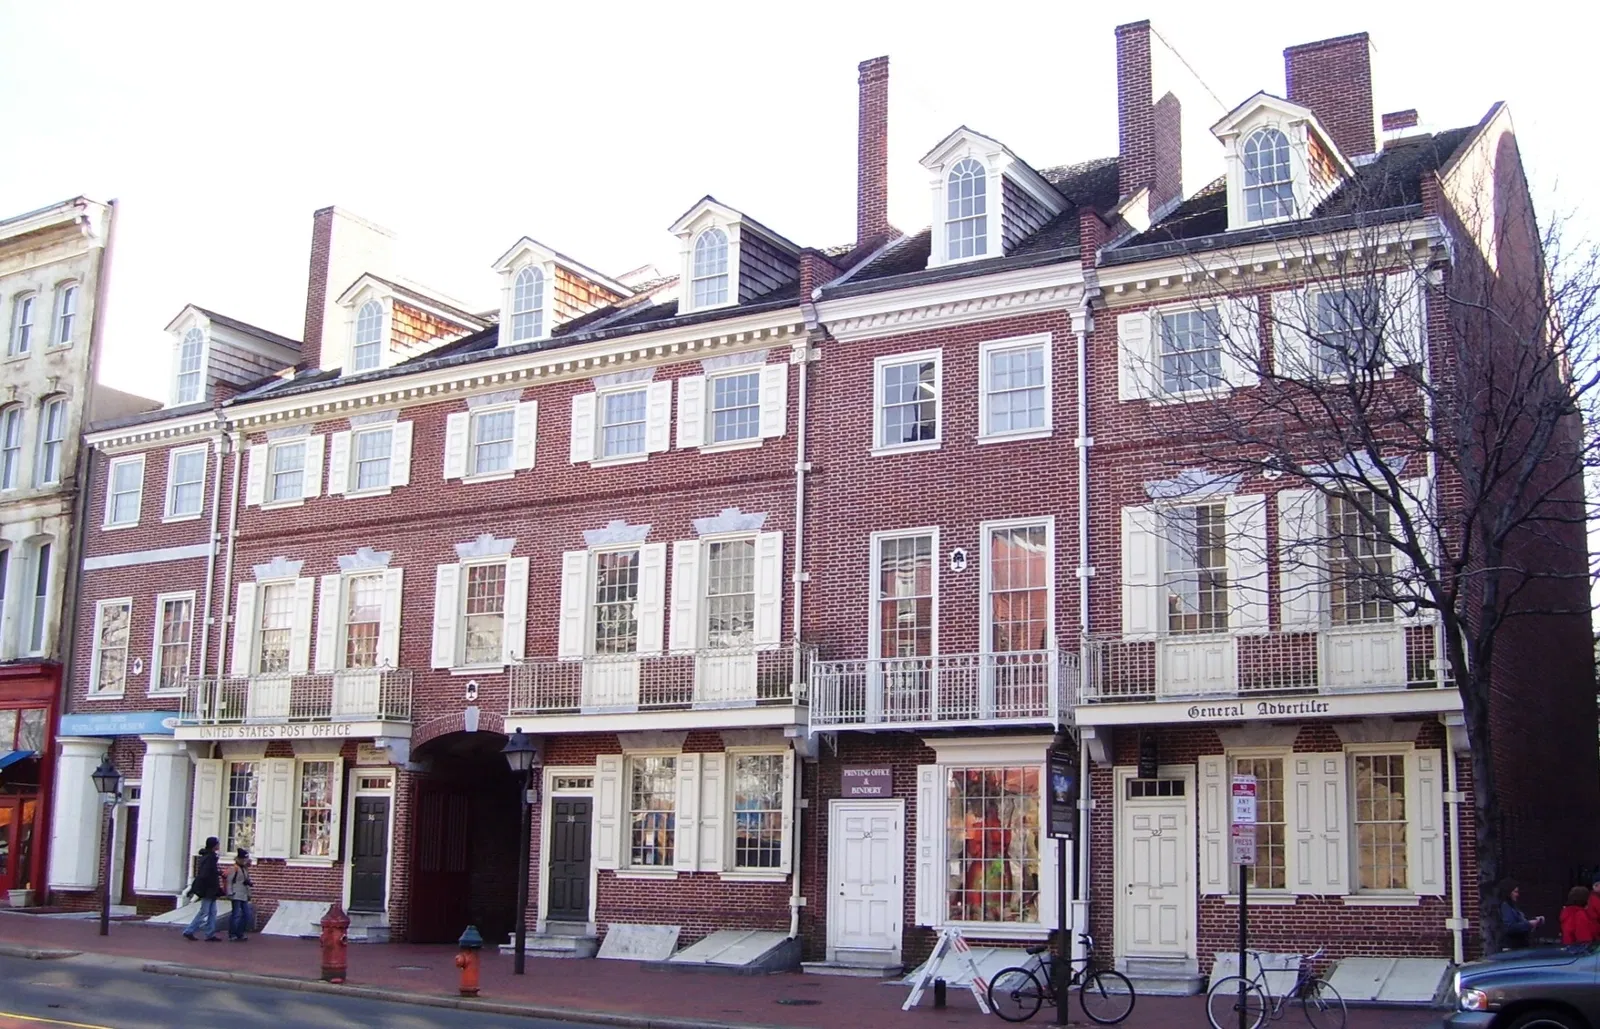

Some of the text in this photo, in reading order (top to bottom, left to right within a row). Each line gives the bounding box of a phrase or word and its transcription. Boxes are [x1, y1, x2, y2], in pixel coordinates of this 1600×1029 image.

[1187, 703, 1245, 719] General
[199, 724, 351, 738] UNITED STATES POST OFFICE
[843, 768, 891, 777] PRINTING OFFICE
[851, 786, 882, 794] BINDERY
[1237, 806, 1251, 814] TIME
[1234, 838, 1253, 846] PRESS
